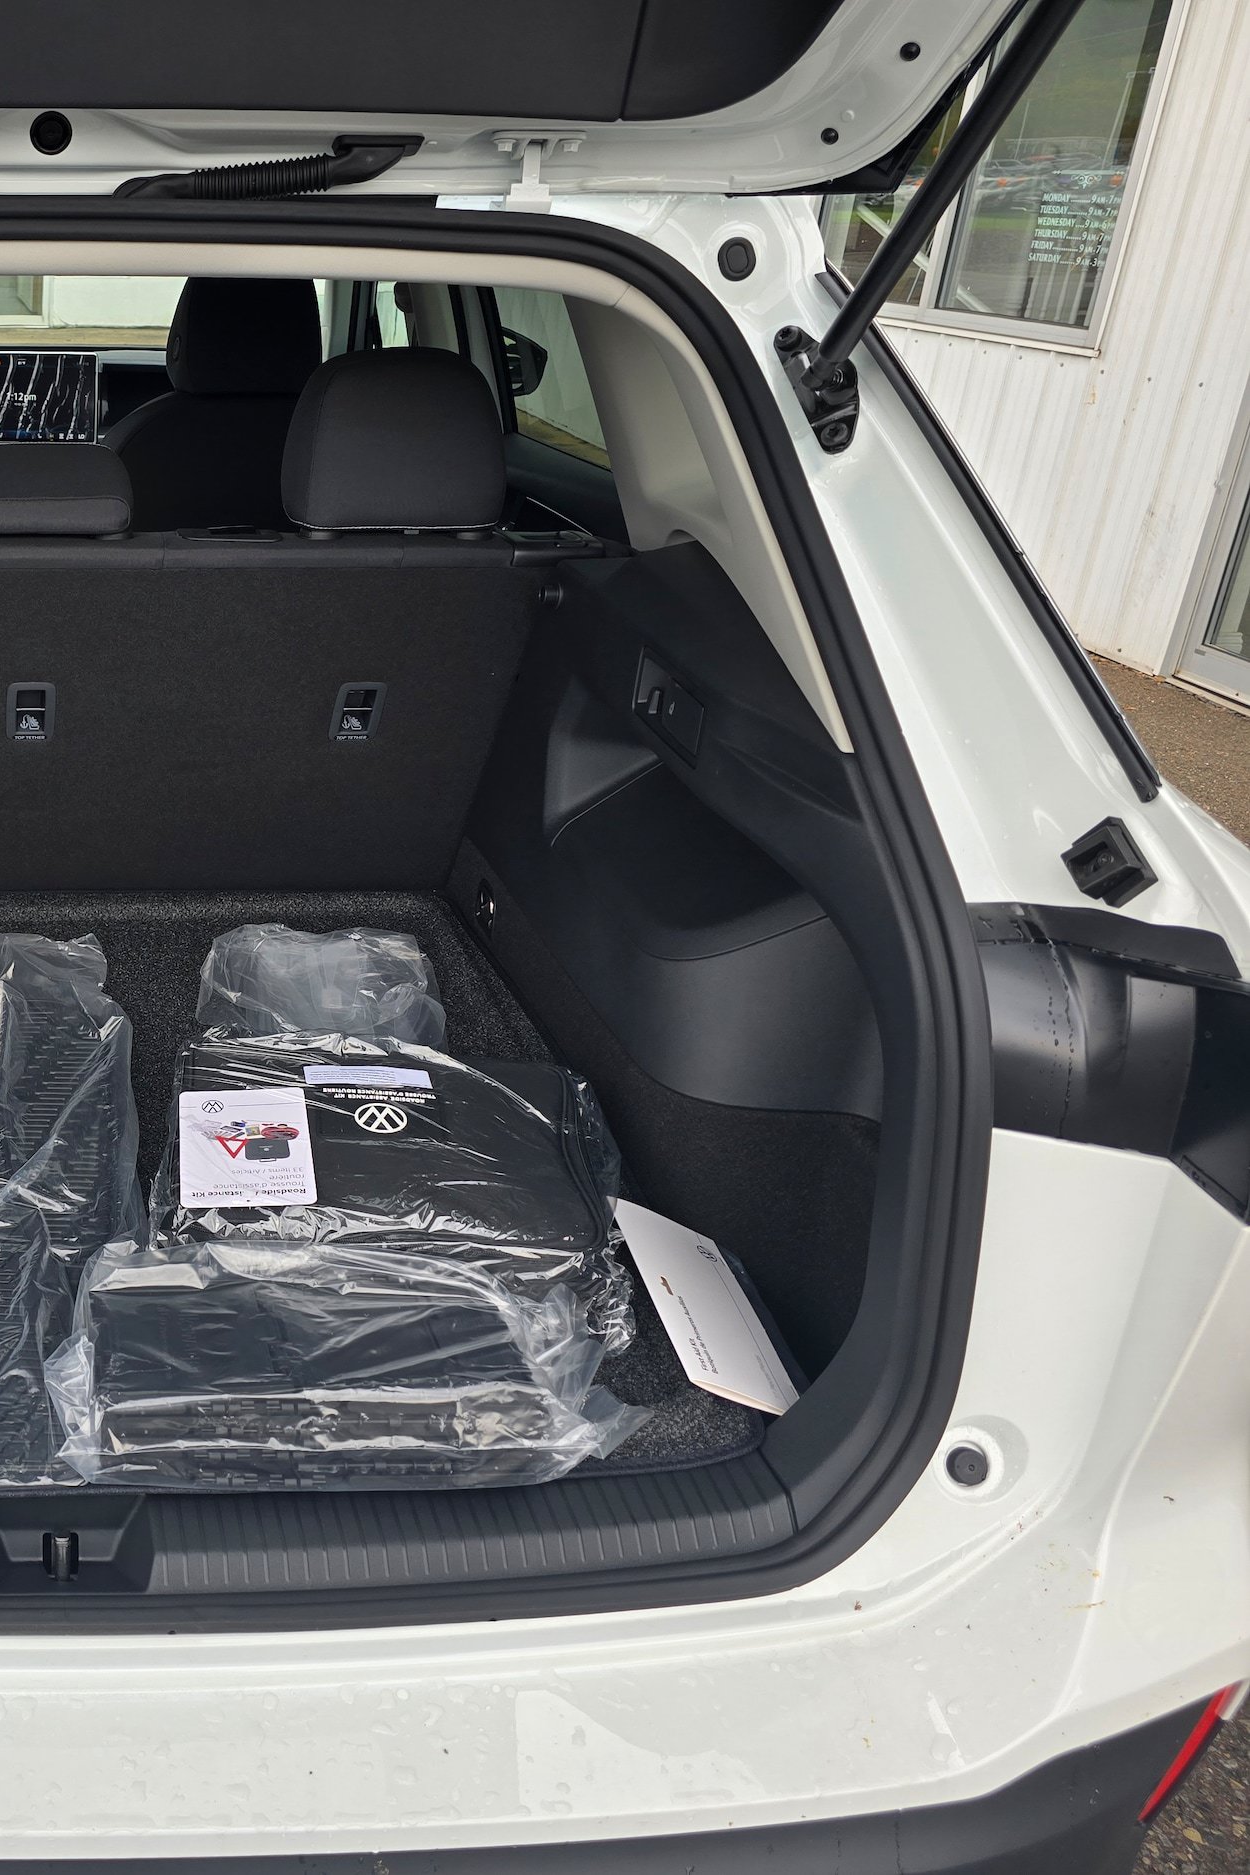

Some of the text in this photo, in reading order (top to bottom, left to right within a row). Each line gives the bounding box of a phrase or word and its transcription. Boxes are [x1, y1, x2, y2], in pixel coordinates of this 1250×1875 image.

[348, 1093, 388, 1101] ASSISTANCE
[390, 1095, 426, 1104] ROADSIDE
[261, 1188, 307, 1196] Roadside
[698, 1356, 710, 1372] First
